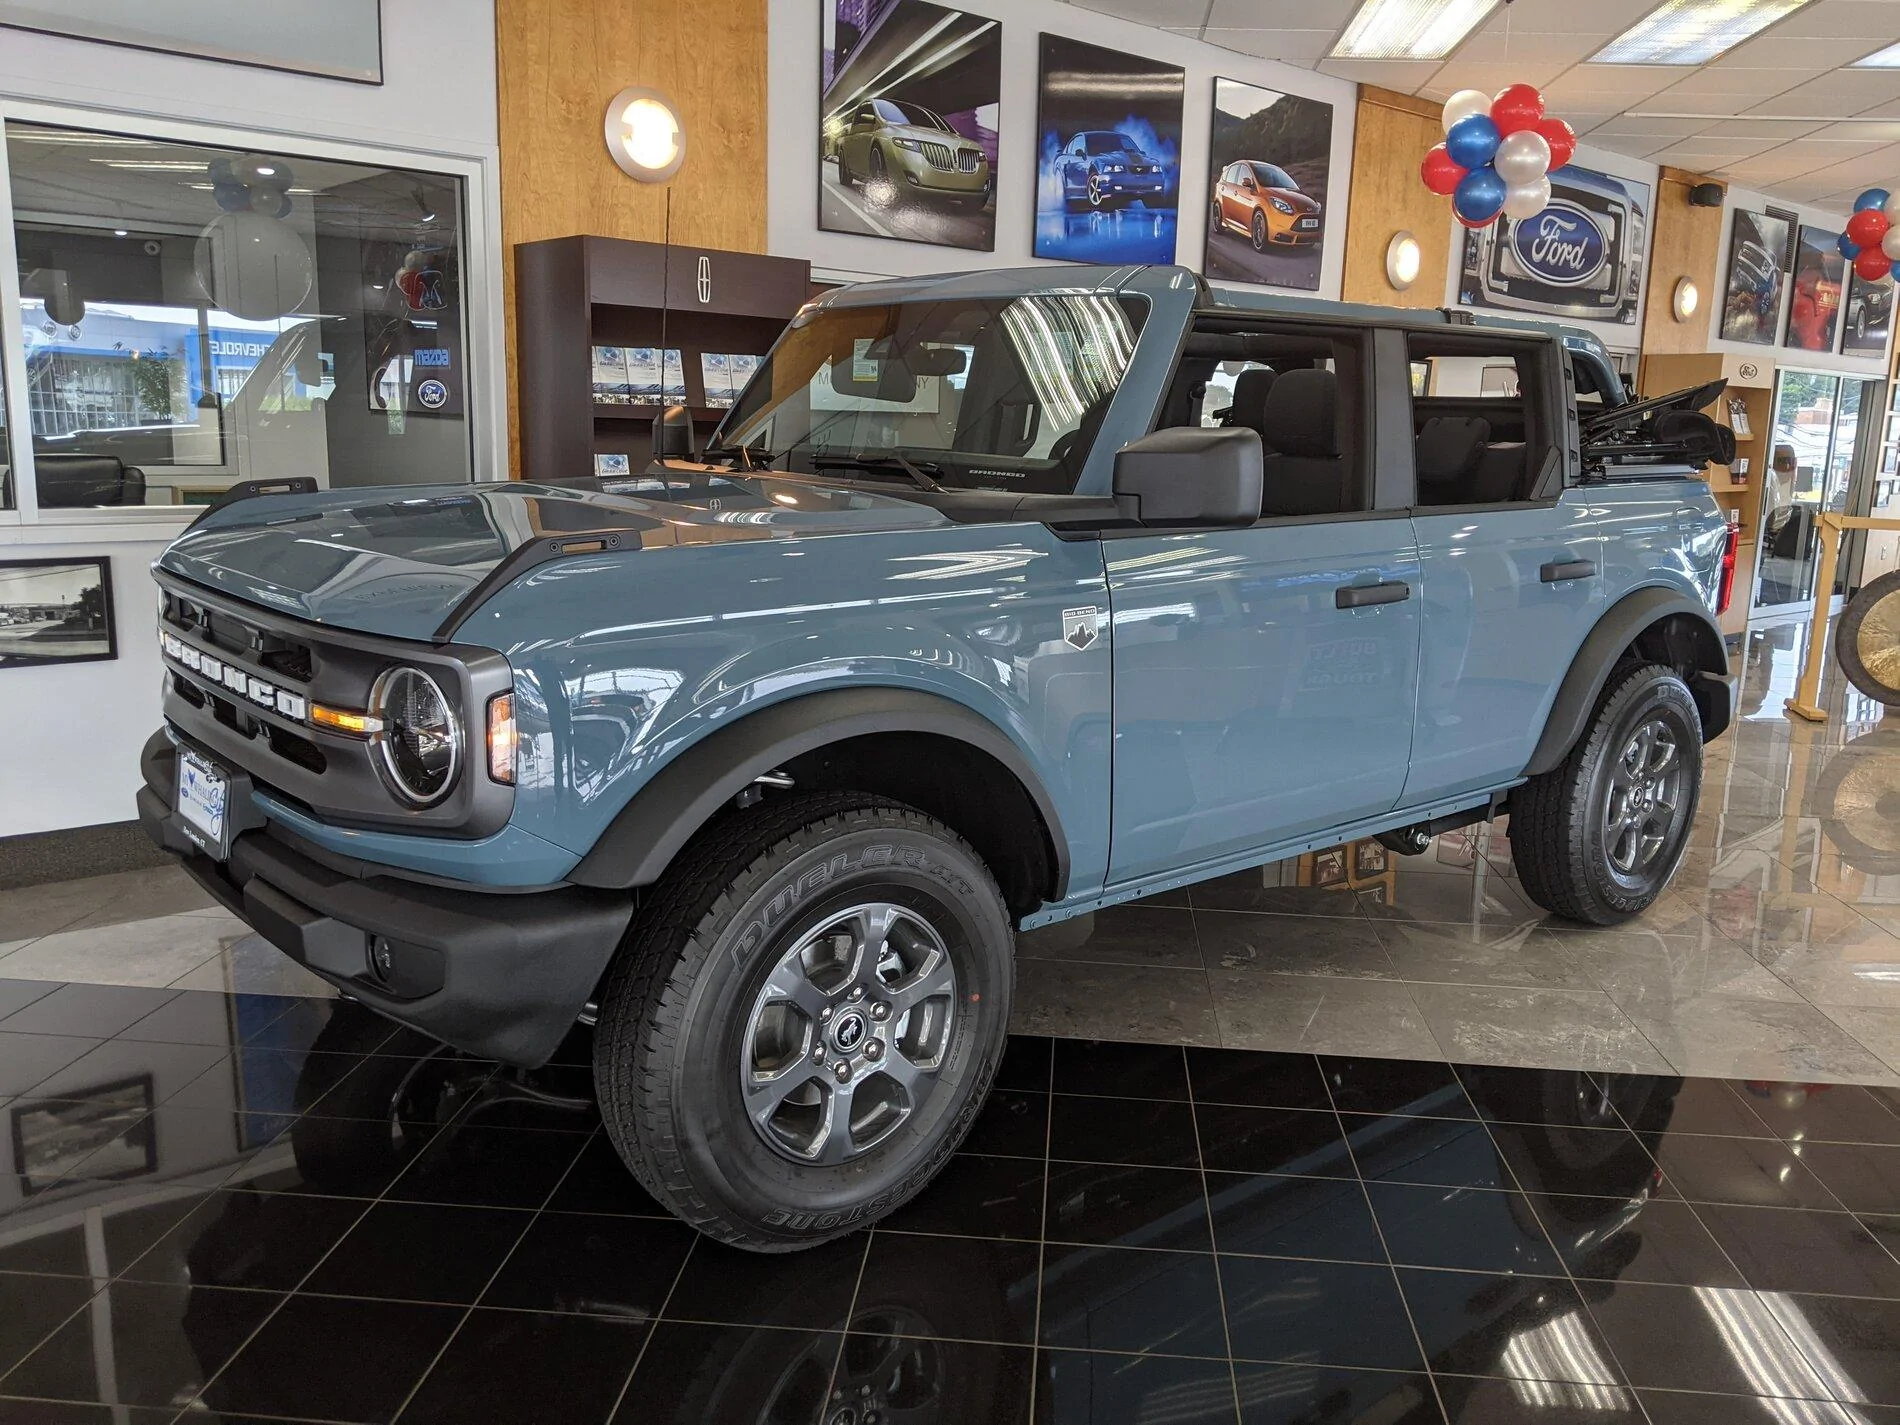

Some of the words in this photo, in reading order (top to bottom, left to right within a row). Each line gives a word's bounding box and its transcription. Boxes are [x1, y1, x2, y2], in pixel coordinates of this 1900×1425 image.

[1531, 215, 1588, 270] Ford
[425, 385, 440, 402] Ford
[969, 469, 1026, 478] BRONCO
[164, 632, 306, 720] BRONCO
[732, 844, 926, 972] DUELER
[762, 1057, 994, 1230] BRIDGESTONE
